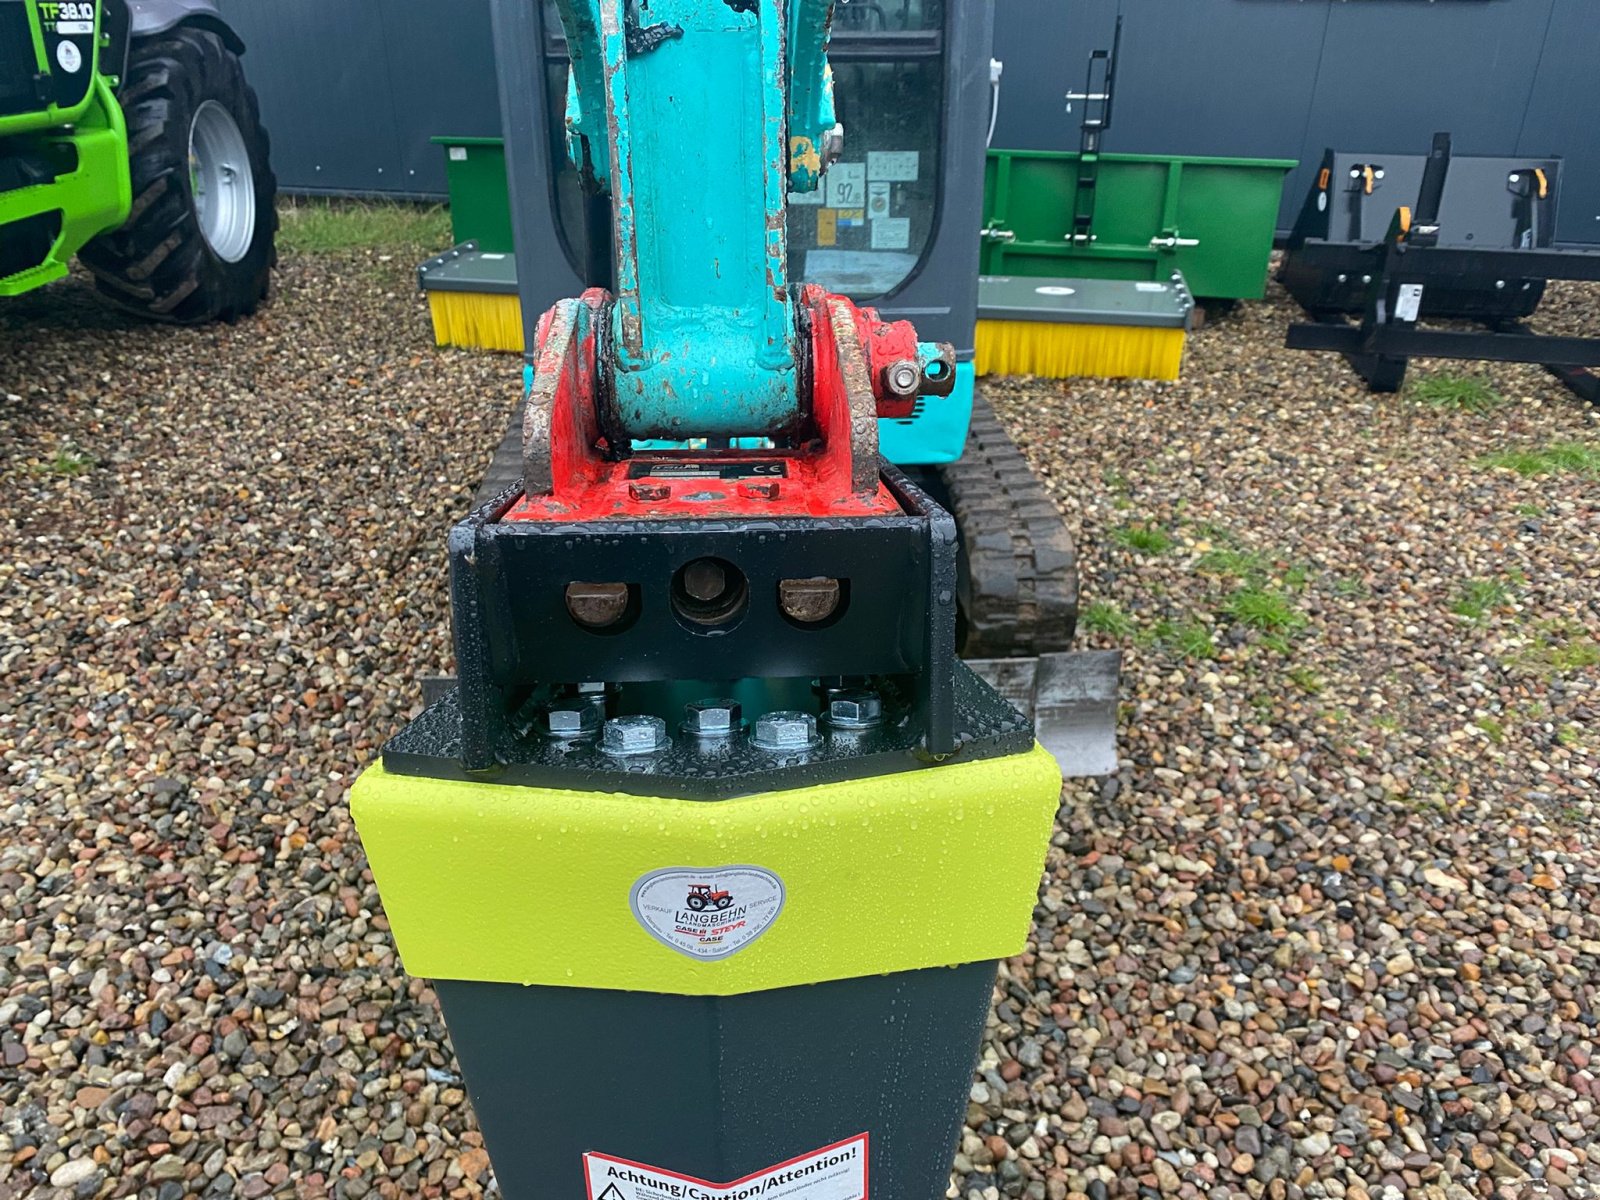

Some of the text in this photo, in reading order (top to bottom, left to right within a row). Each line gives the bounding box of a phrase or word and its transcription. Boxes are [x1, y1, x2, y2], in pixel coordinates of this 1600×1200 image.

[39, 3, 94, 19] TF38.10
[643, 904, 673, 914] VERKAUF
[749, 895, 777, 909] SERVICE
[675, 905, 747, 924] LANGBEHN
[675, 925, 698, 933] CASE
[711, 920, 747, 935] STEYR
